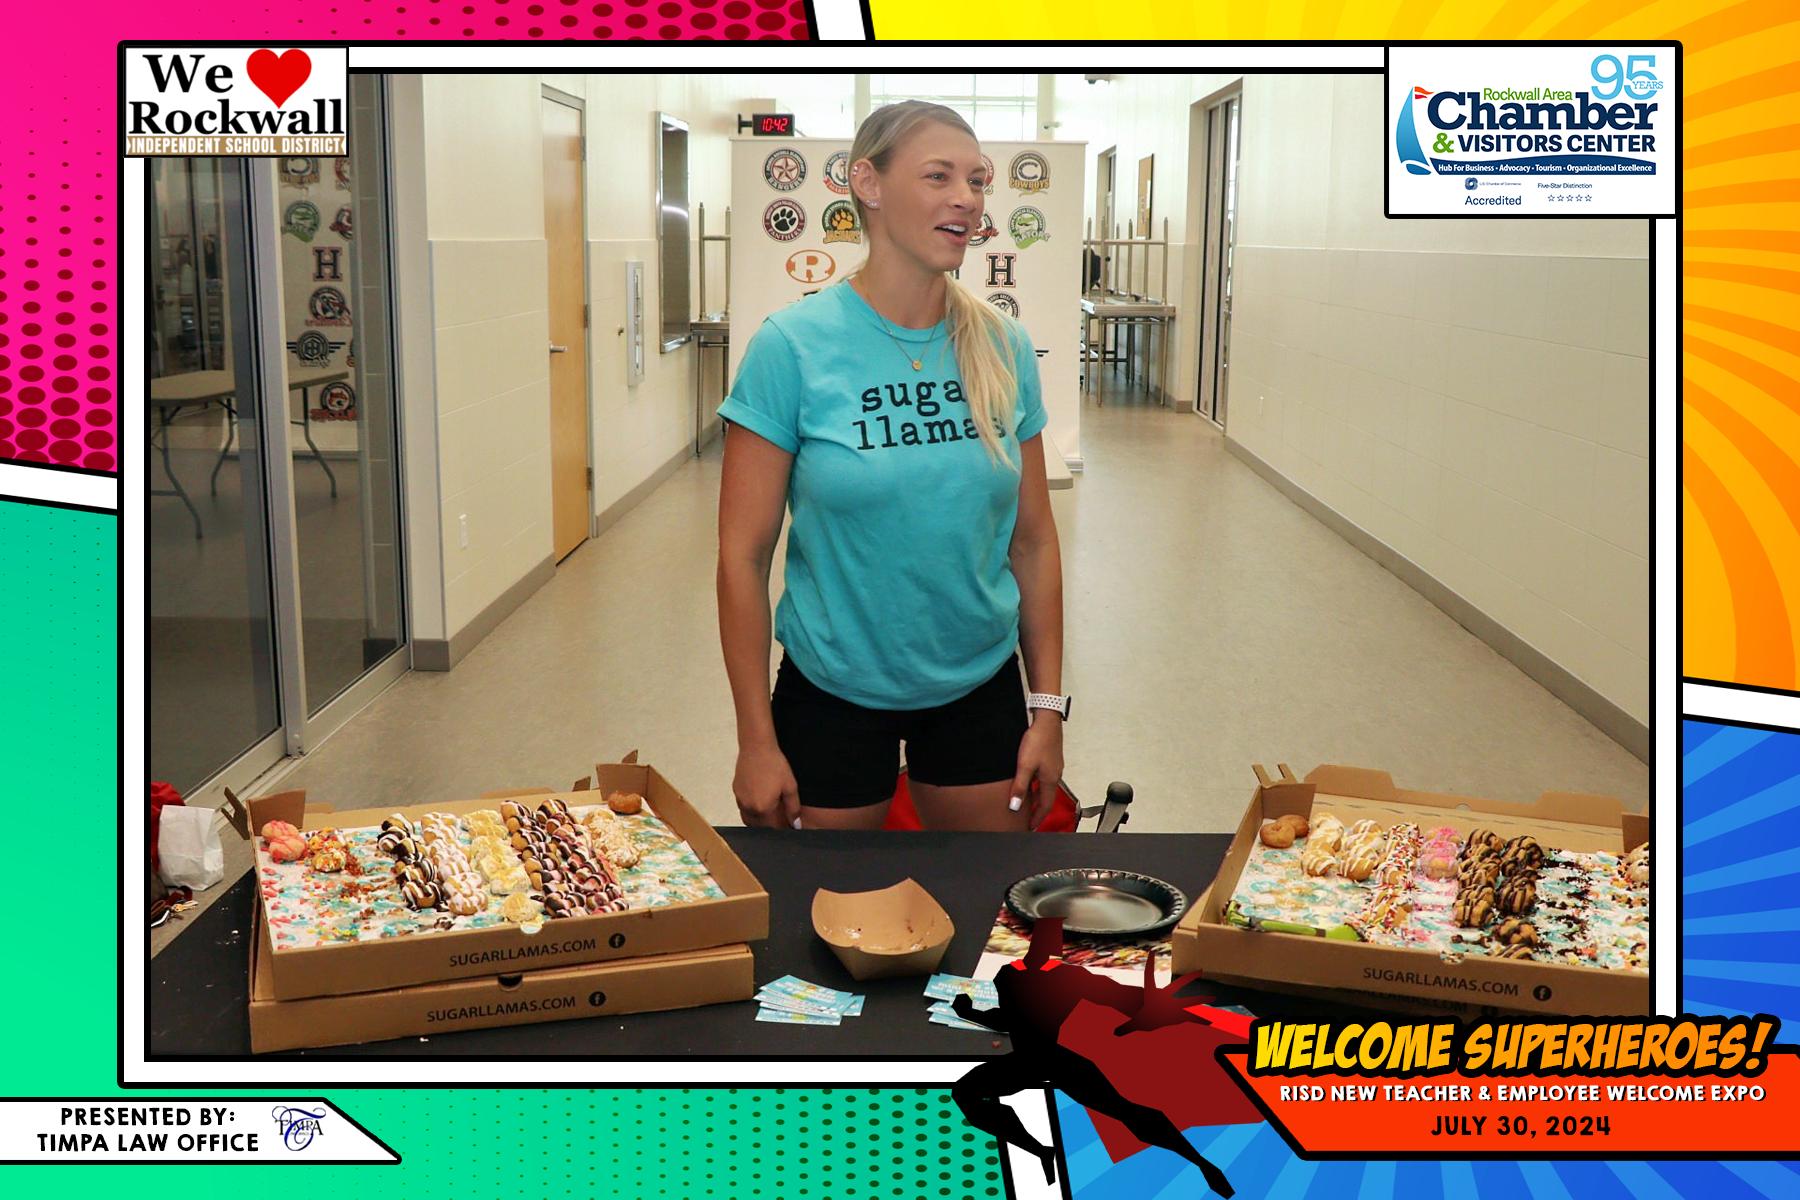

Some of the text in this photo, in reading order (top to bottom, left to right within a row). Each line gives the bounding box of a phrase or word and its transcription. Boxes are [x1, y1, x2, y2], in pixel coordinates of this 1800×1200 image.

[762, 117, 789, 132] 10:42
[986, 253, 1016, 288] H
[861, 379, 968, 417] suga
[449, 938, 597, 967] SUGARLLAMAS.COM
[1363, 967, 1519, 996] SUGARLLAMAS.COM
[427, 996, 576, 1022] SUGARLLAMAS.COM
